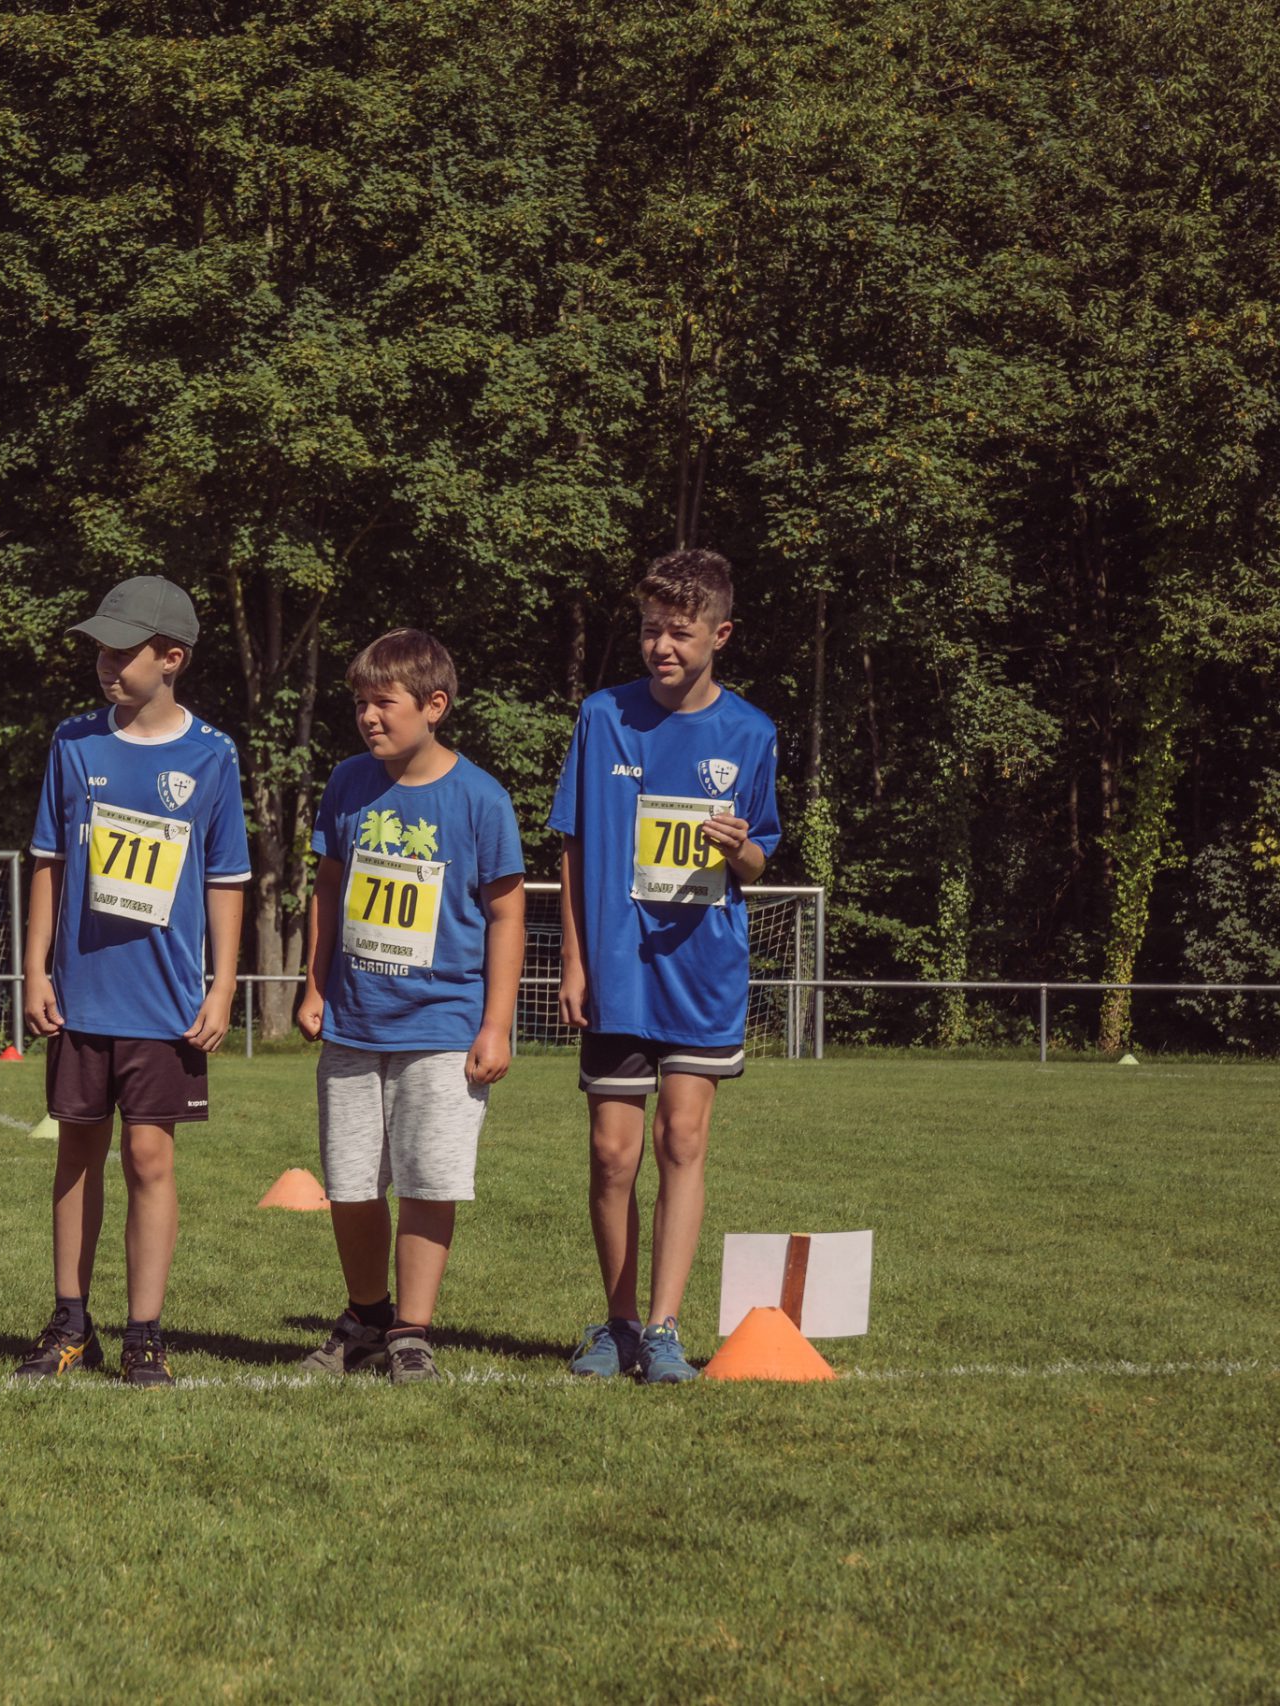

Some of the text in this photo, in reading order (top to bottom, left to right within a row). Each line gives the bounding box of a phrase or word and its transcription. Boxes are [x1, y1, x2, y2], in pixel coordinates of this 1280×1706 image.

[88, 776, 108, 786] AKO
[611, 764, 643, 778] JAKO
[654, 821, 710, 868] 709
[101, 831, 162, 885] 711
[647, 882, 674, 893] LAUF
[93, 892, 153, 914] LAUF WEISE
[362, 876, 419, 929] 710
[355, 937, 414, 957] LAUF WEISE
